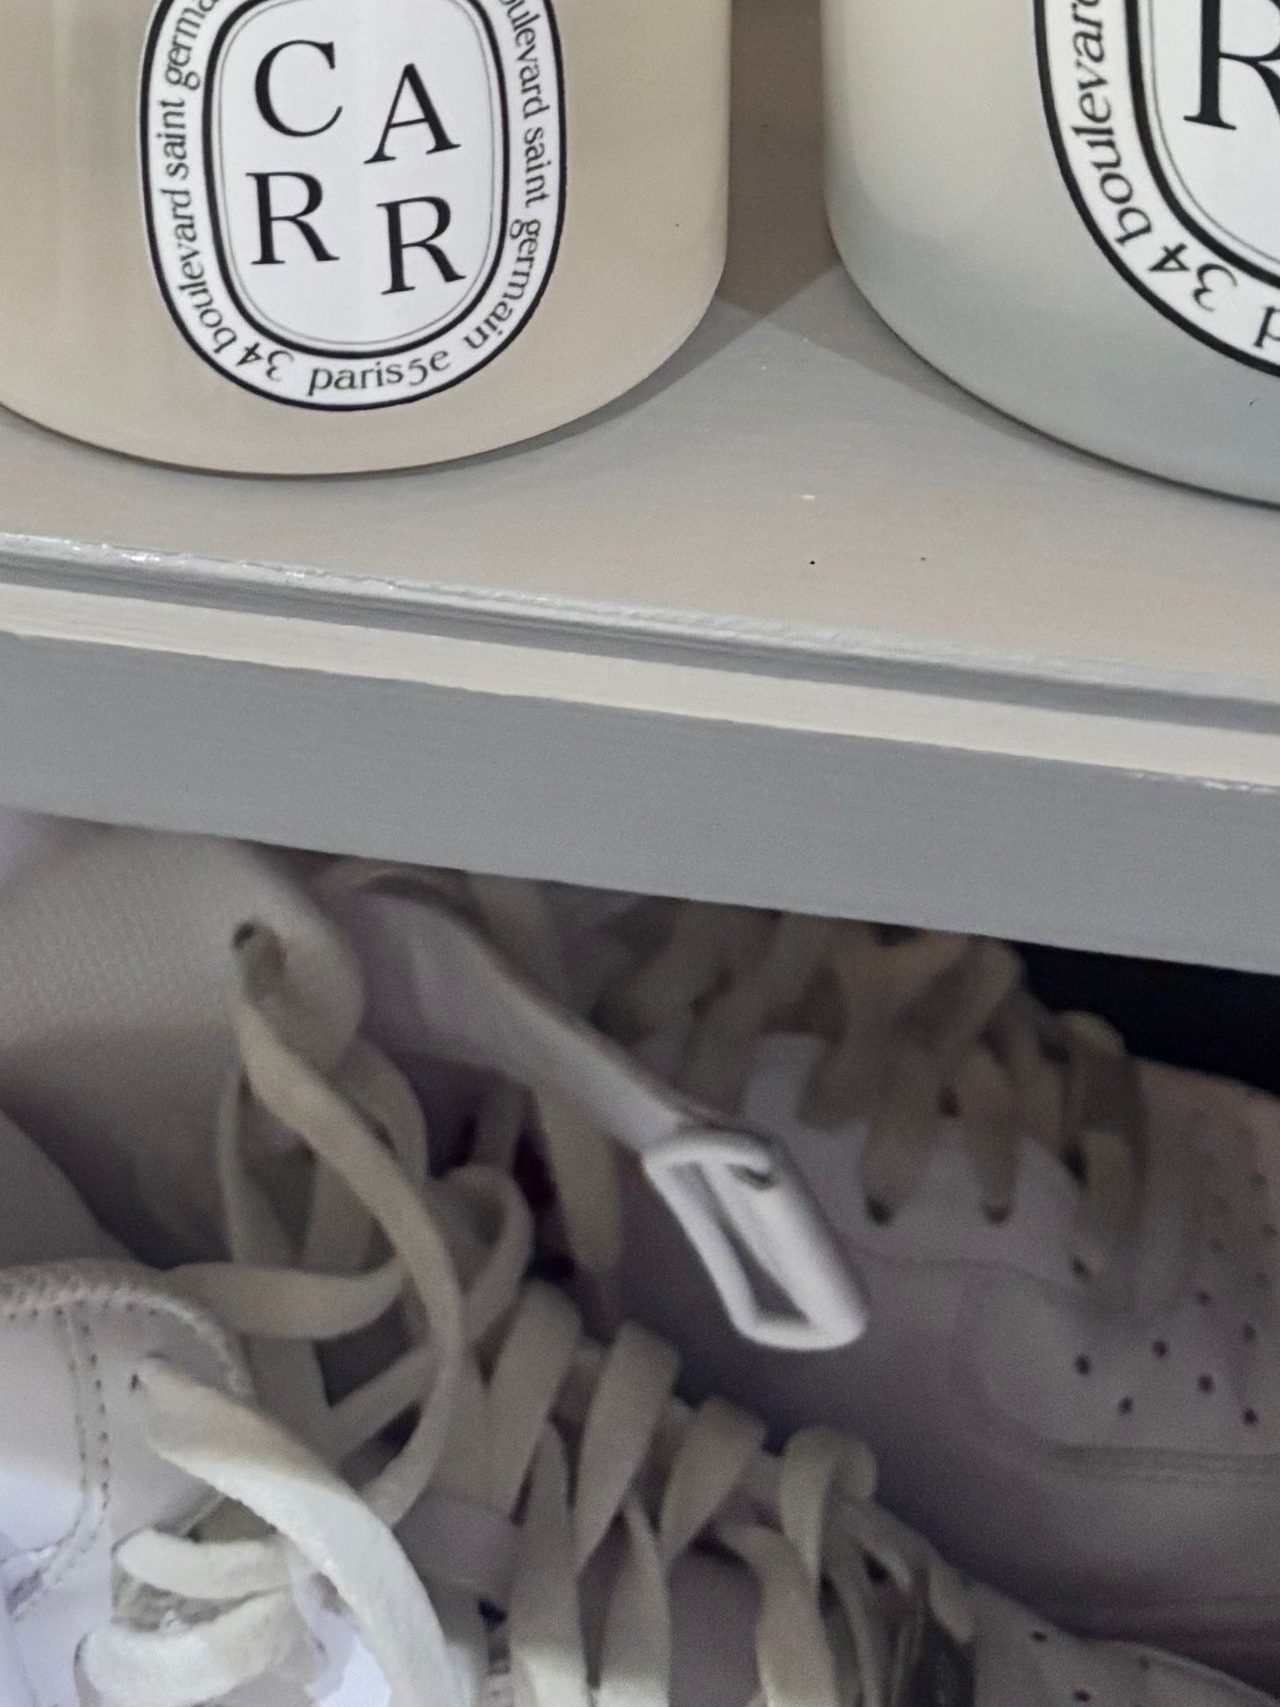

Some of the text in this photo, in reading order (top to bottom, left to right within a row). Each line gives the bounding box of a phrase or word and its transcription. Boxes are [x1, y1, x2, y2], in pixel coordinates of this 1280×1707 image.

[157, 98, 188, 180] saint
[524, 128, 550, 209] saint
[162, 189, 238, 353] boulevard
[464, 218, 542, 351] germain
